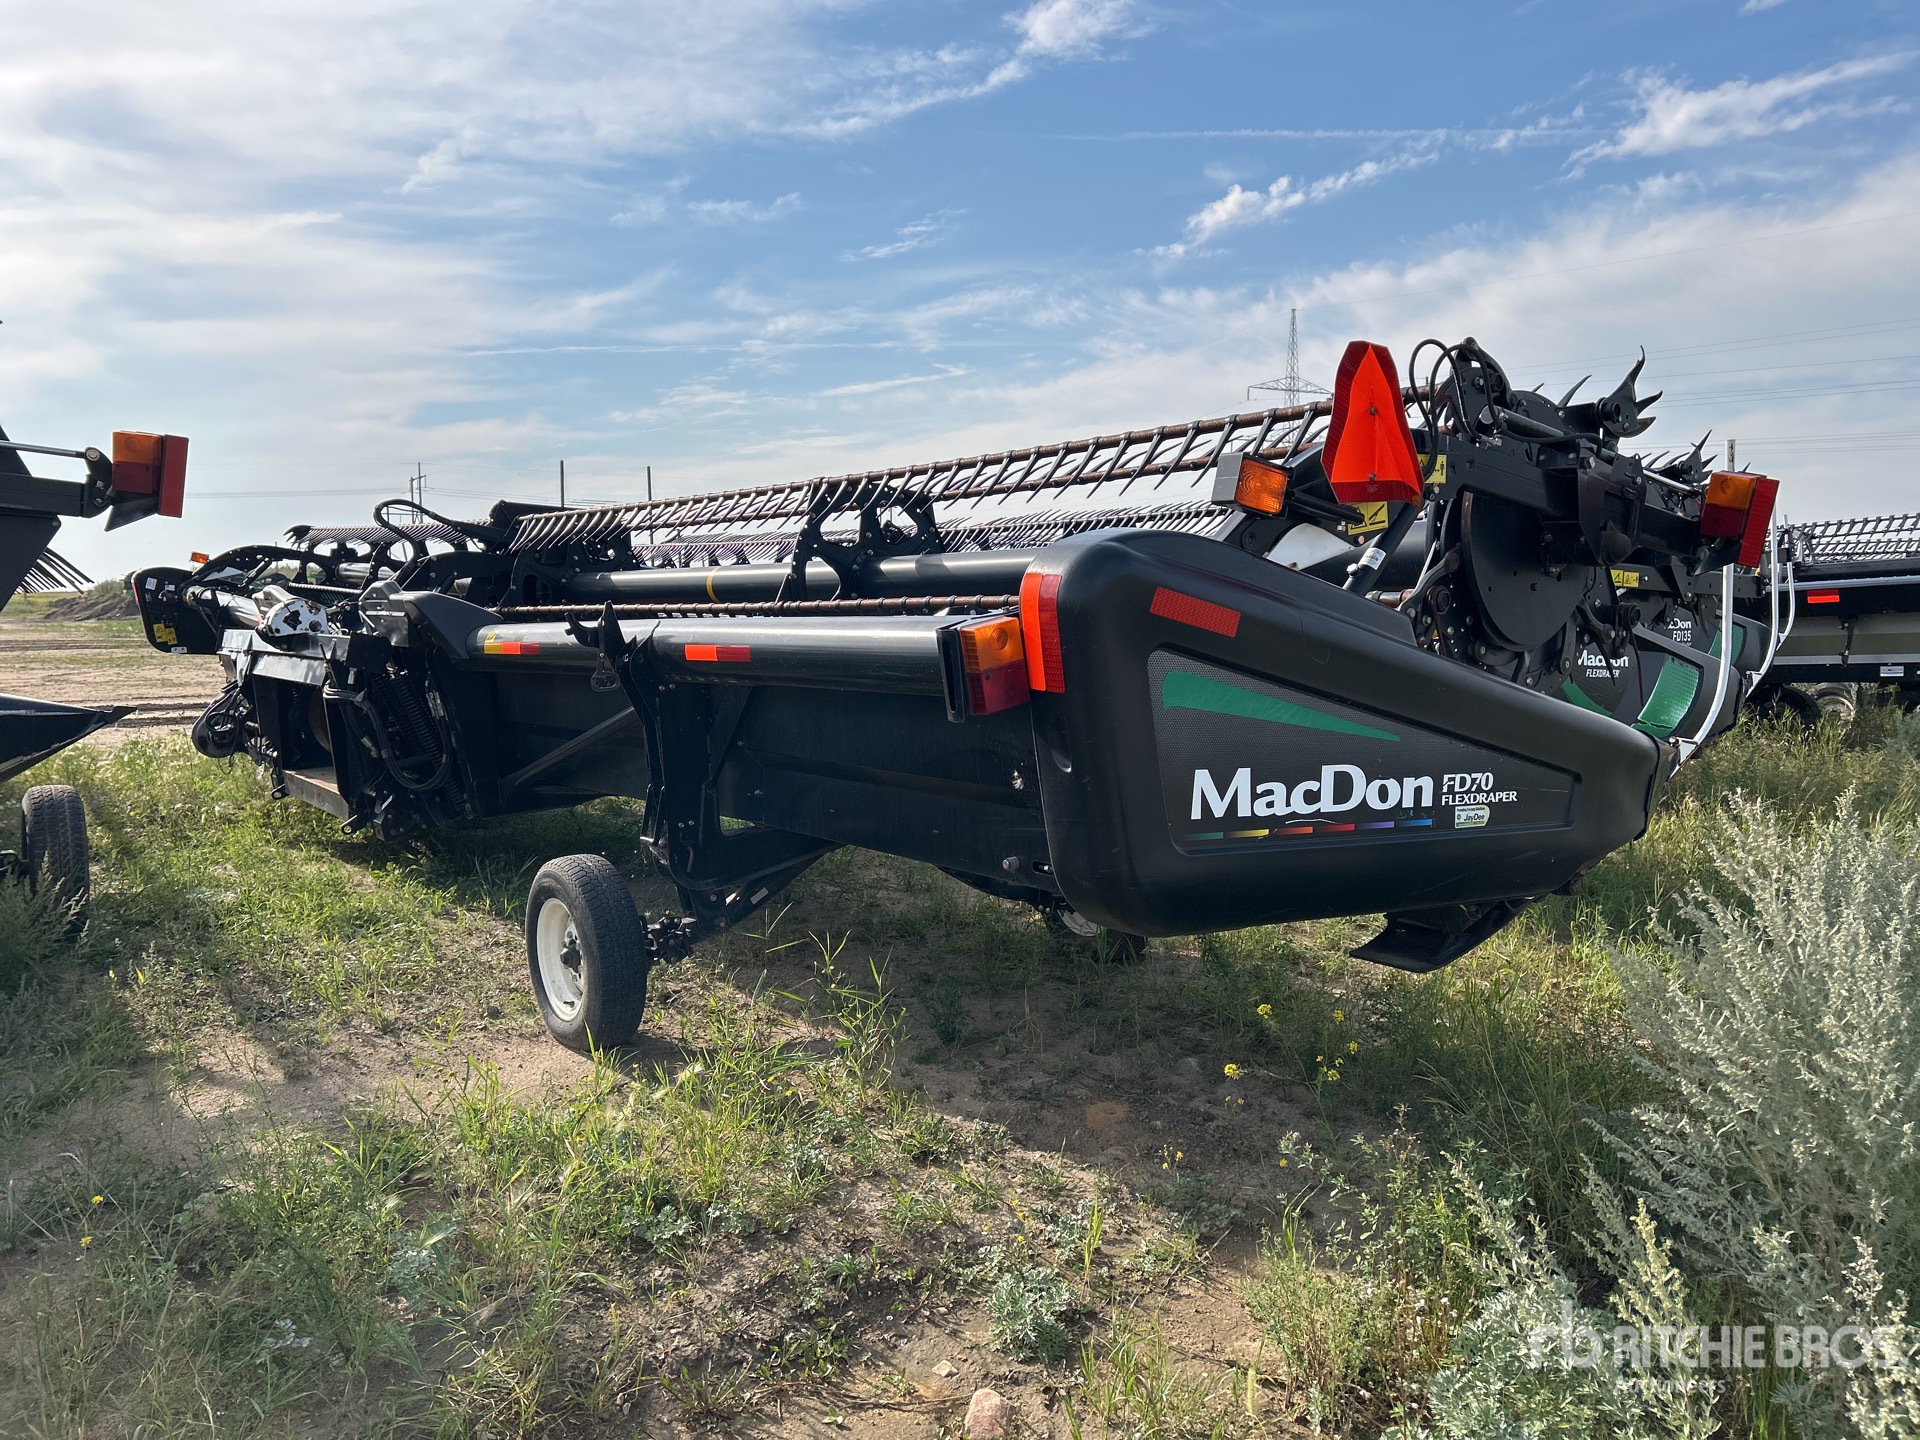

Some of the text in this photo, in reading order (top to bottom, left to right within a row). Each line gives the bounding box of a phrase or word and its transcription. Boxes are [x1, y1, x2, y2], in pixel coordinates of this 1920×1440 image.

[1672, 630, 1692, 642] FD135
[1190, 763, 1434, 820] MacDon
[1442, 772, 1494, 793] FD70
[1441, 791, 1518, 806] FLEXDRAPER
